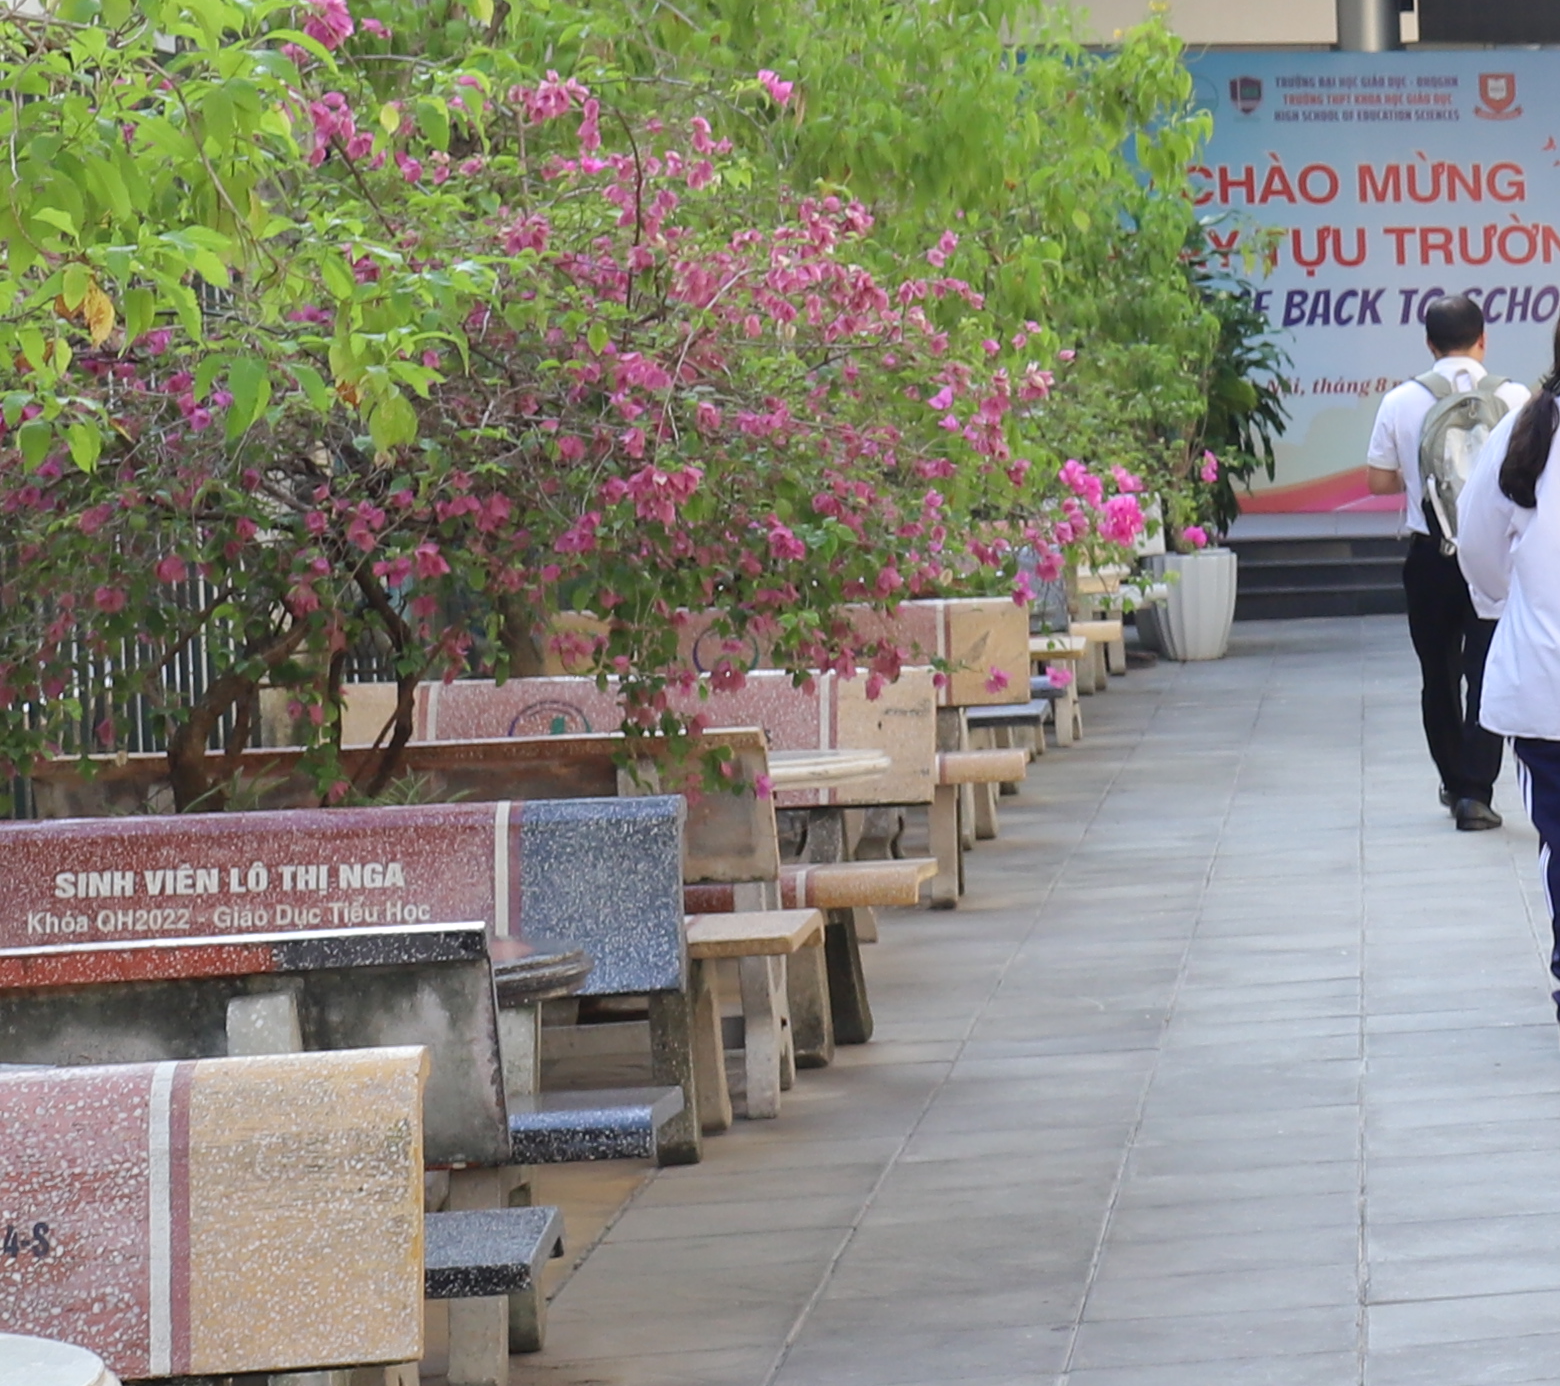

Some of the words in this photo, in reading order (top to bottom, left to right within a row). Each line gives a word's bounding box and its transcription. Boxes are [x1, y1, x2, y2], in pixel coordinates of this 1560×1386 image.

[1182, 151, 1340, 206] CHÀO
[1357, 150, 1527, 205] MỪNG
[1282, 287, 1386, 328] BACK
[1312, 376, 1366, 397] tháng
[1368, 377, 1388, 395] 8
[55, 871, 134, 898] SINH
[144, 863, 219, 896] VIÊN
[229, 862, 268, 893] LÔ
[281, 864, 327, 896] THỊ
[339, 862, 405, 890] NGA
[27, 909, 89, 935] Khóa
[97, 908, 190, 934] QH2022
[213, 903, 268, 930] Giáo
[276, 902, 321, 930] Dục
[330, 897, 378, 925] Tiểu
[385, 899, 431, 925] Học
